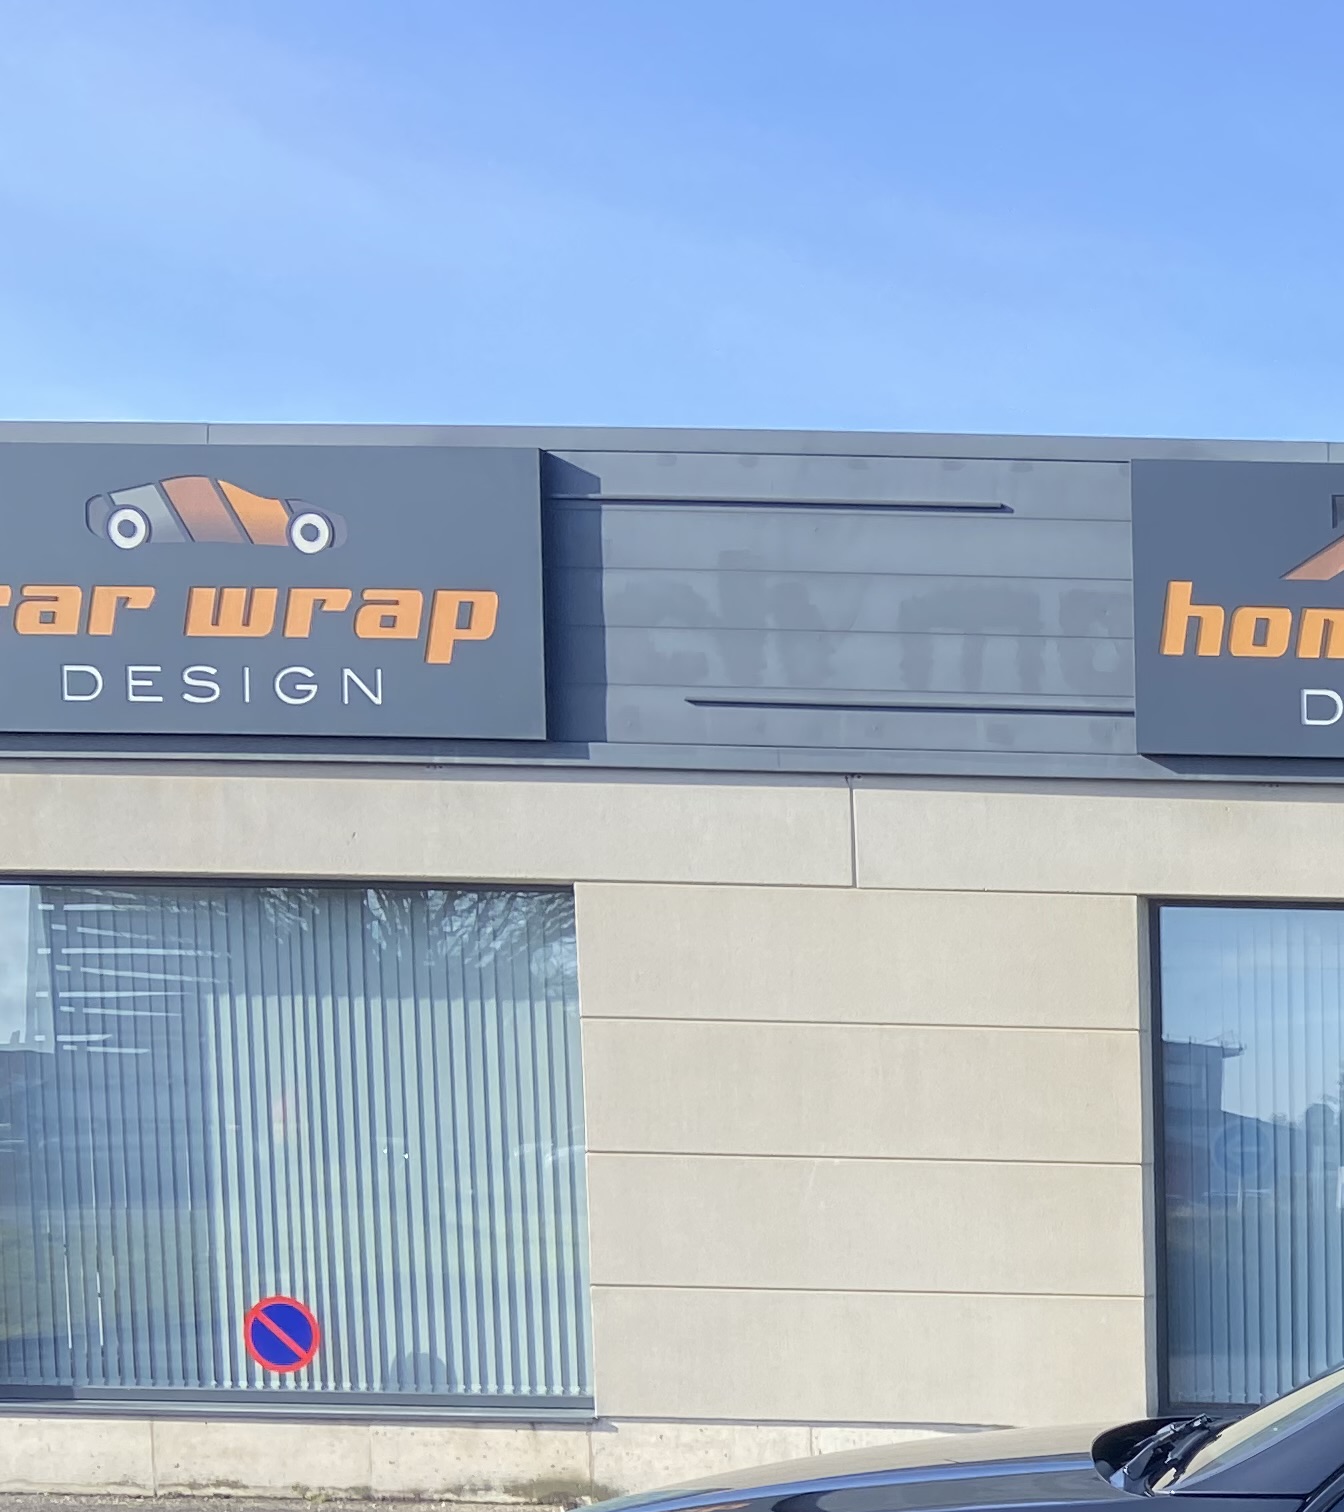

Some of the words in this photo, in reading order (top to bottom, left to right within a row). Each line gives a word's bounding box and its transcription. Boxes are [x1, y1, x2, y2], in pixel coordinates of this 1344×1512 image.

[0, 584, 156, 636] ar
[184, 585, 500, 665] wrap
[61, 664, 384, 706] DESIGN
